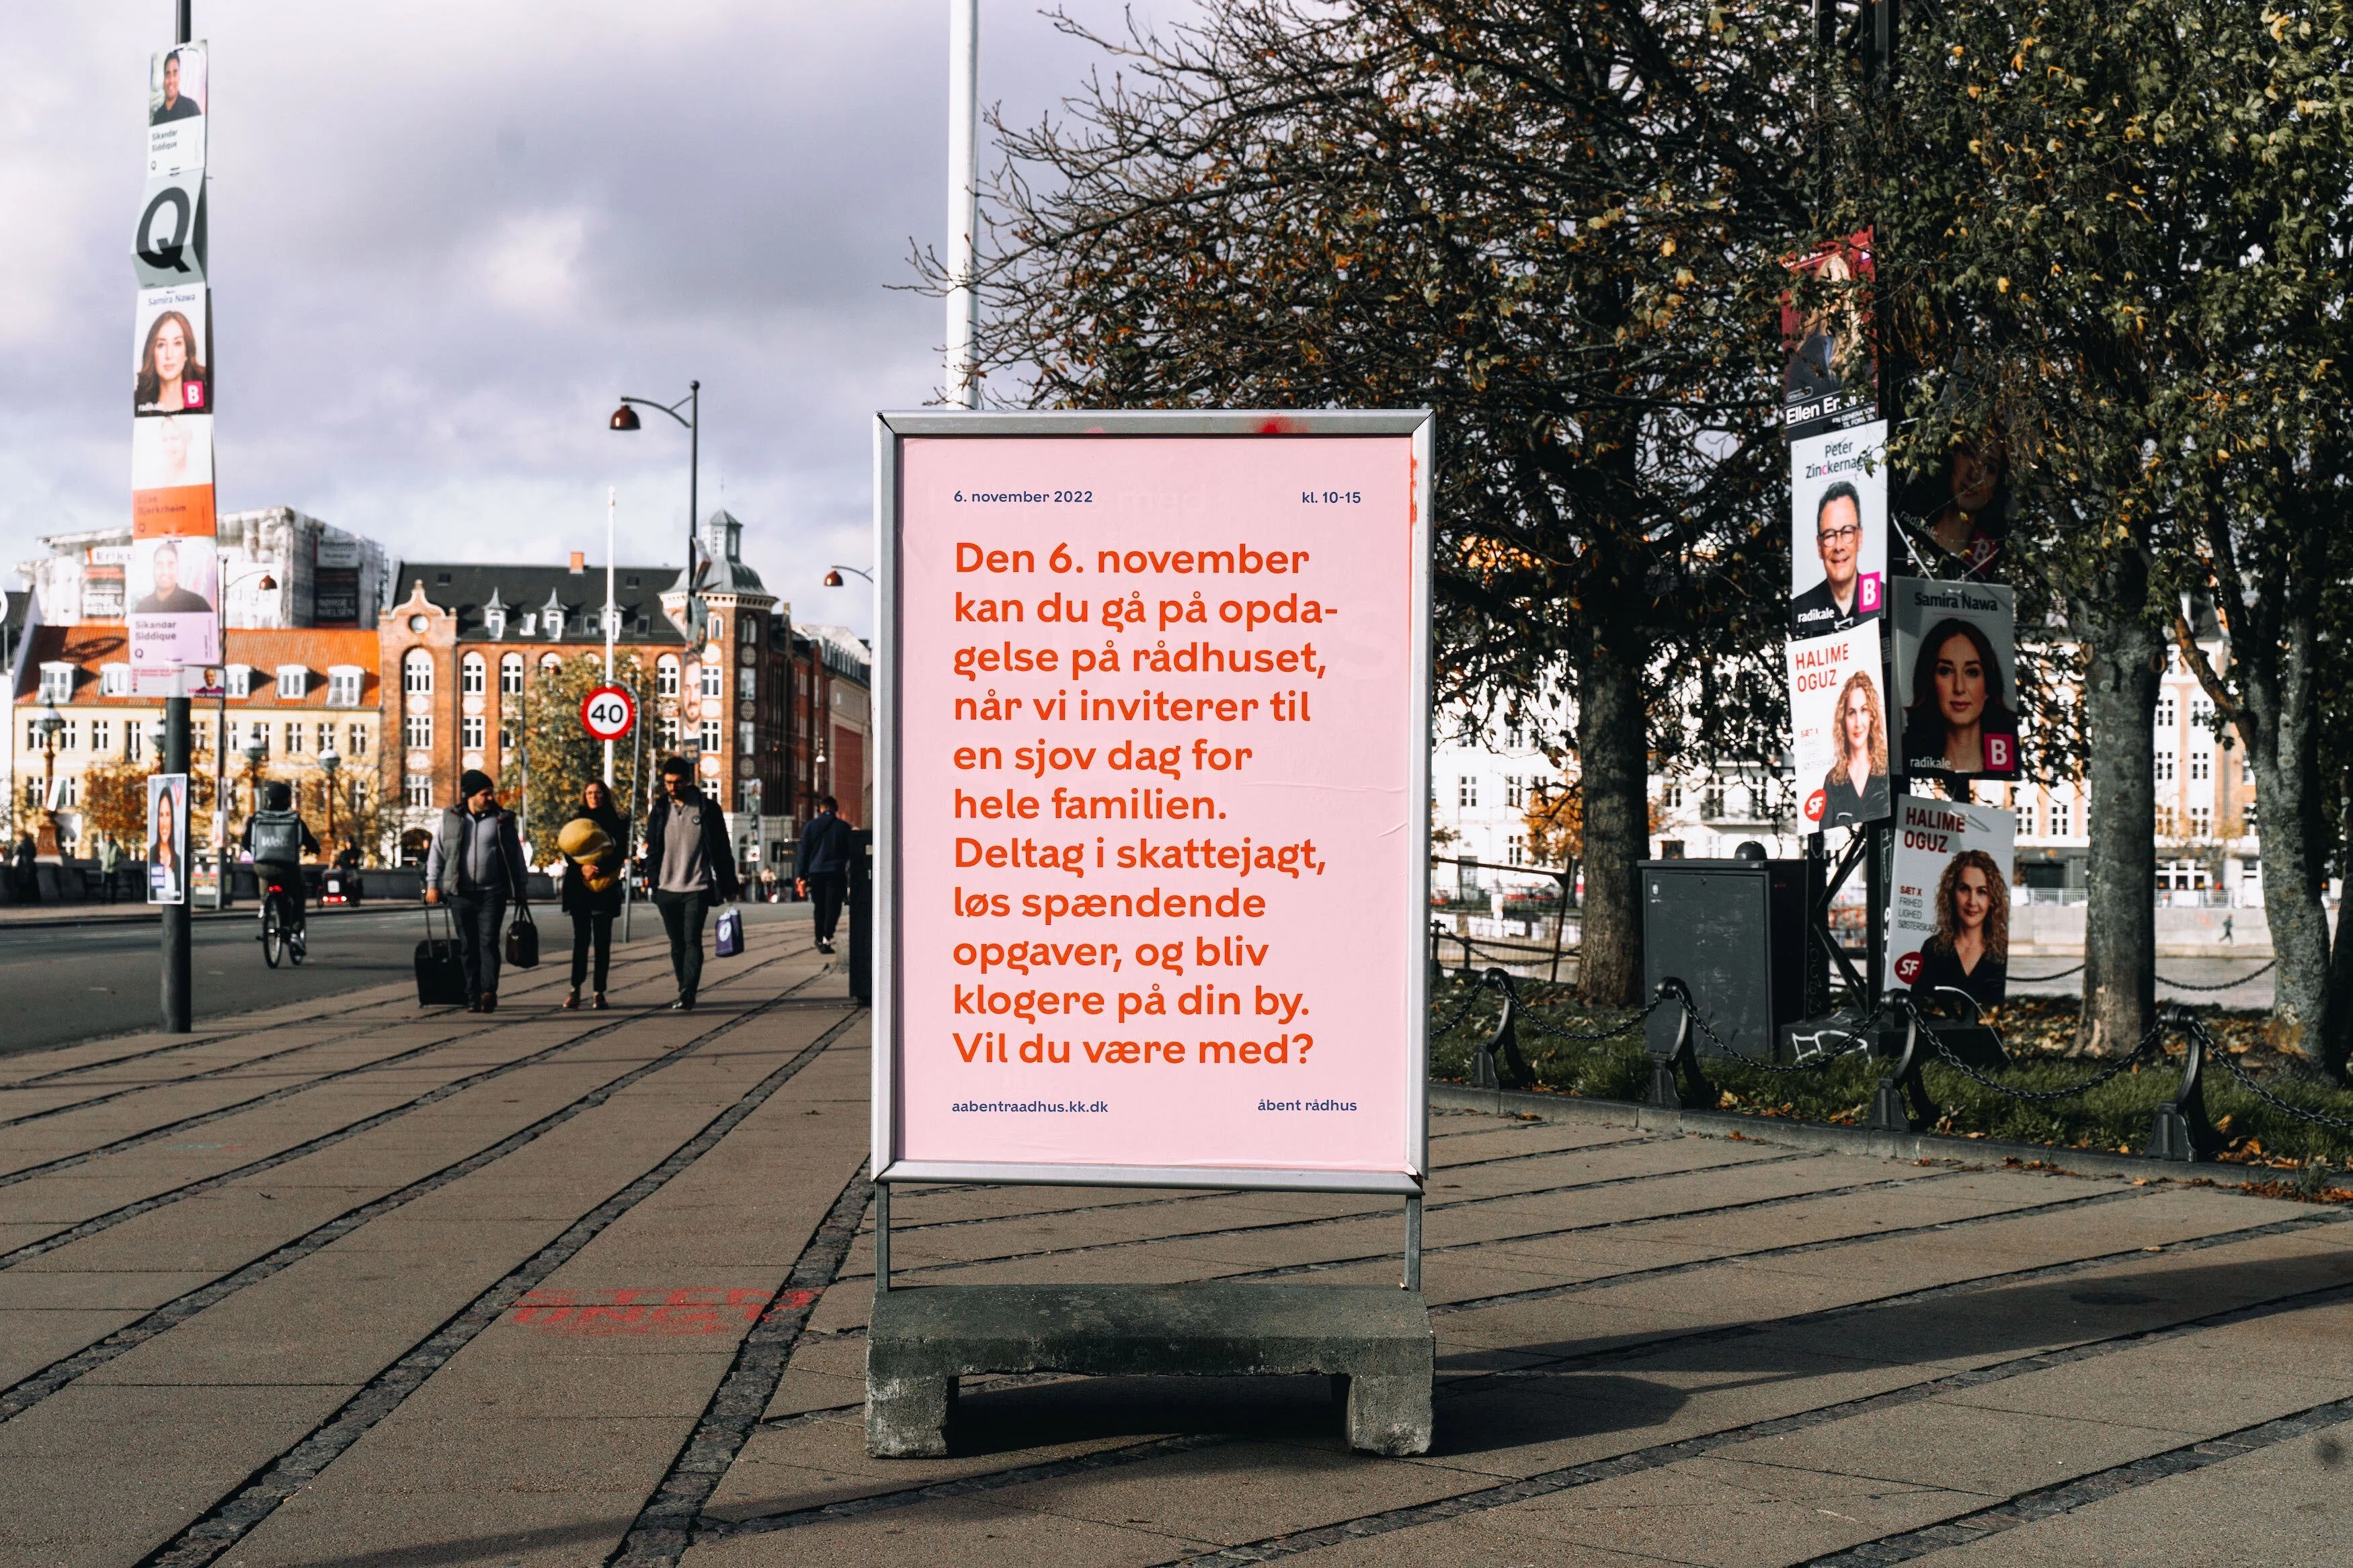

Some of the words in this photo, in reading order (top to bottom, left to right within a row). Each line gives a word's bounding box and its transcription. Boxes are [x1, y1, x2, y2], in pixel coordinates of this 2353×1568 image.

[136, 187, 192, 274] Q
[188, 385, 199, 404] B
[1786, 404, 1820, 425] Ellen
[1825, 442, 1853, 458] Peter
[954, 491, 967, 502] 6.
[972, 491, 1049, 502] november
[1054, 491, 1092, 502] 2022
[1302, 491, 1318, 503] kl.
[1322, 491, 1361, 503] 10-15
[957, 542, 1035, 573] Den
[1049, 542, 1084, 573] 6.
[1099, 543, 1310, 574] november
[1863, 578, 1876, 606] B
[1915, 591, 1959, 608] Samira
[1962, 592, 1998, 611] Nawa
[956, 591, 1024, 622] kan
[1037, 591, 1088, 623] du
[1102, 590, 1146, 632] gå
[1160, 591, 1207, 631] på
[1220, 593, 1338, 632] opda-
[1798, 607, 1835, 623] radikale
[136, 620, 177, 628] Sikandar
[136, 632, 177, 641] Siddique
[134, 649, 144, 659] Q
[954, 641, 1059, 682] gelse
[1073, 639, 1121, 680] på
[1133, 640, 1326, 679] rådhuset,
[1796, 643, 1848, 670] HALIME
[1798, 669, 1837, 693] OGUZ
[591, 704, 623, 724] 40
[955, 688, 1023, 721] når
[1033, 689, 1066, 720] vi
[1081, 689, 1259, 722] inviterer
[1270, 690, 1310, 722] til
[954, 747, 1002, 770] en
[1015, 738, 1097, 779] sjov
[1108, 739, 1181, 780] dag
[1192, 738, 1252, 771] for
[1910, 756, 1951, 768] radikale
[1991, 739, 2007, 766] B
[955, 788, 1040, 819] hele
[1051, 787, 1226, 820] familien.
[1808, 796, 1823, 815] SF
[1905, 806, 1965, 833] HALIME
[1904, 827, 1948, 854] OGUZ
[956, 837, 1084, 878] Deltag
[1096, 837, 1105, 868] i
[1117, 837, 1326, 879] skattejagt,
[1917, 888, 1922, 897] X
[955, 886, 1010, 918] løs
[1023, 886, 1266, 925] spændende
[953, 938, 1122, 976] opgaver,
[1135, 941, 1184, 977] og
[1197, 934, 1269, 966] bliv
[1899, 959, 1919, 975] SF
[955, 984, 1105, 1024] klogere
[1119, 983, 1166, 1023] på
[1179, 983, 1240, 1016] din
[1256, 985, 1309, 1025] by.
[953, 1032, 1008, 1063] Vil
[1020, 1033, 1070, 1064] du
[1083, 1040, 1186, 1064] være
[1199, 1033, 1314, 1065] med?
[952, 1100, 1109, 1113] aabentraadhus.kk.dk
[1257, 1099, 1302, 1111] åbent
[1306, 1099, 1357, 1111] rådhus
